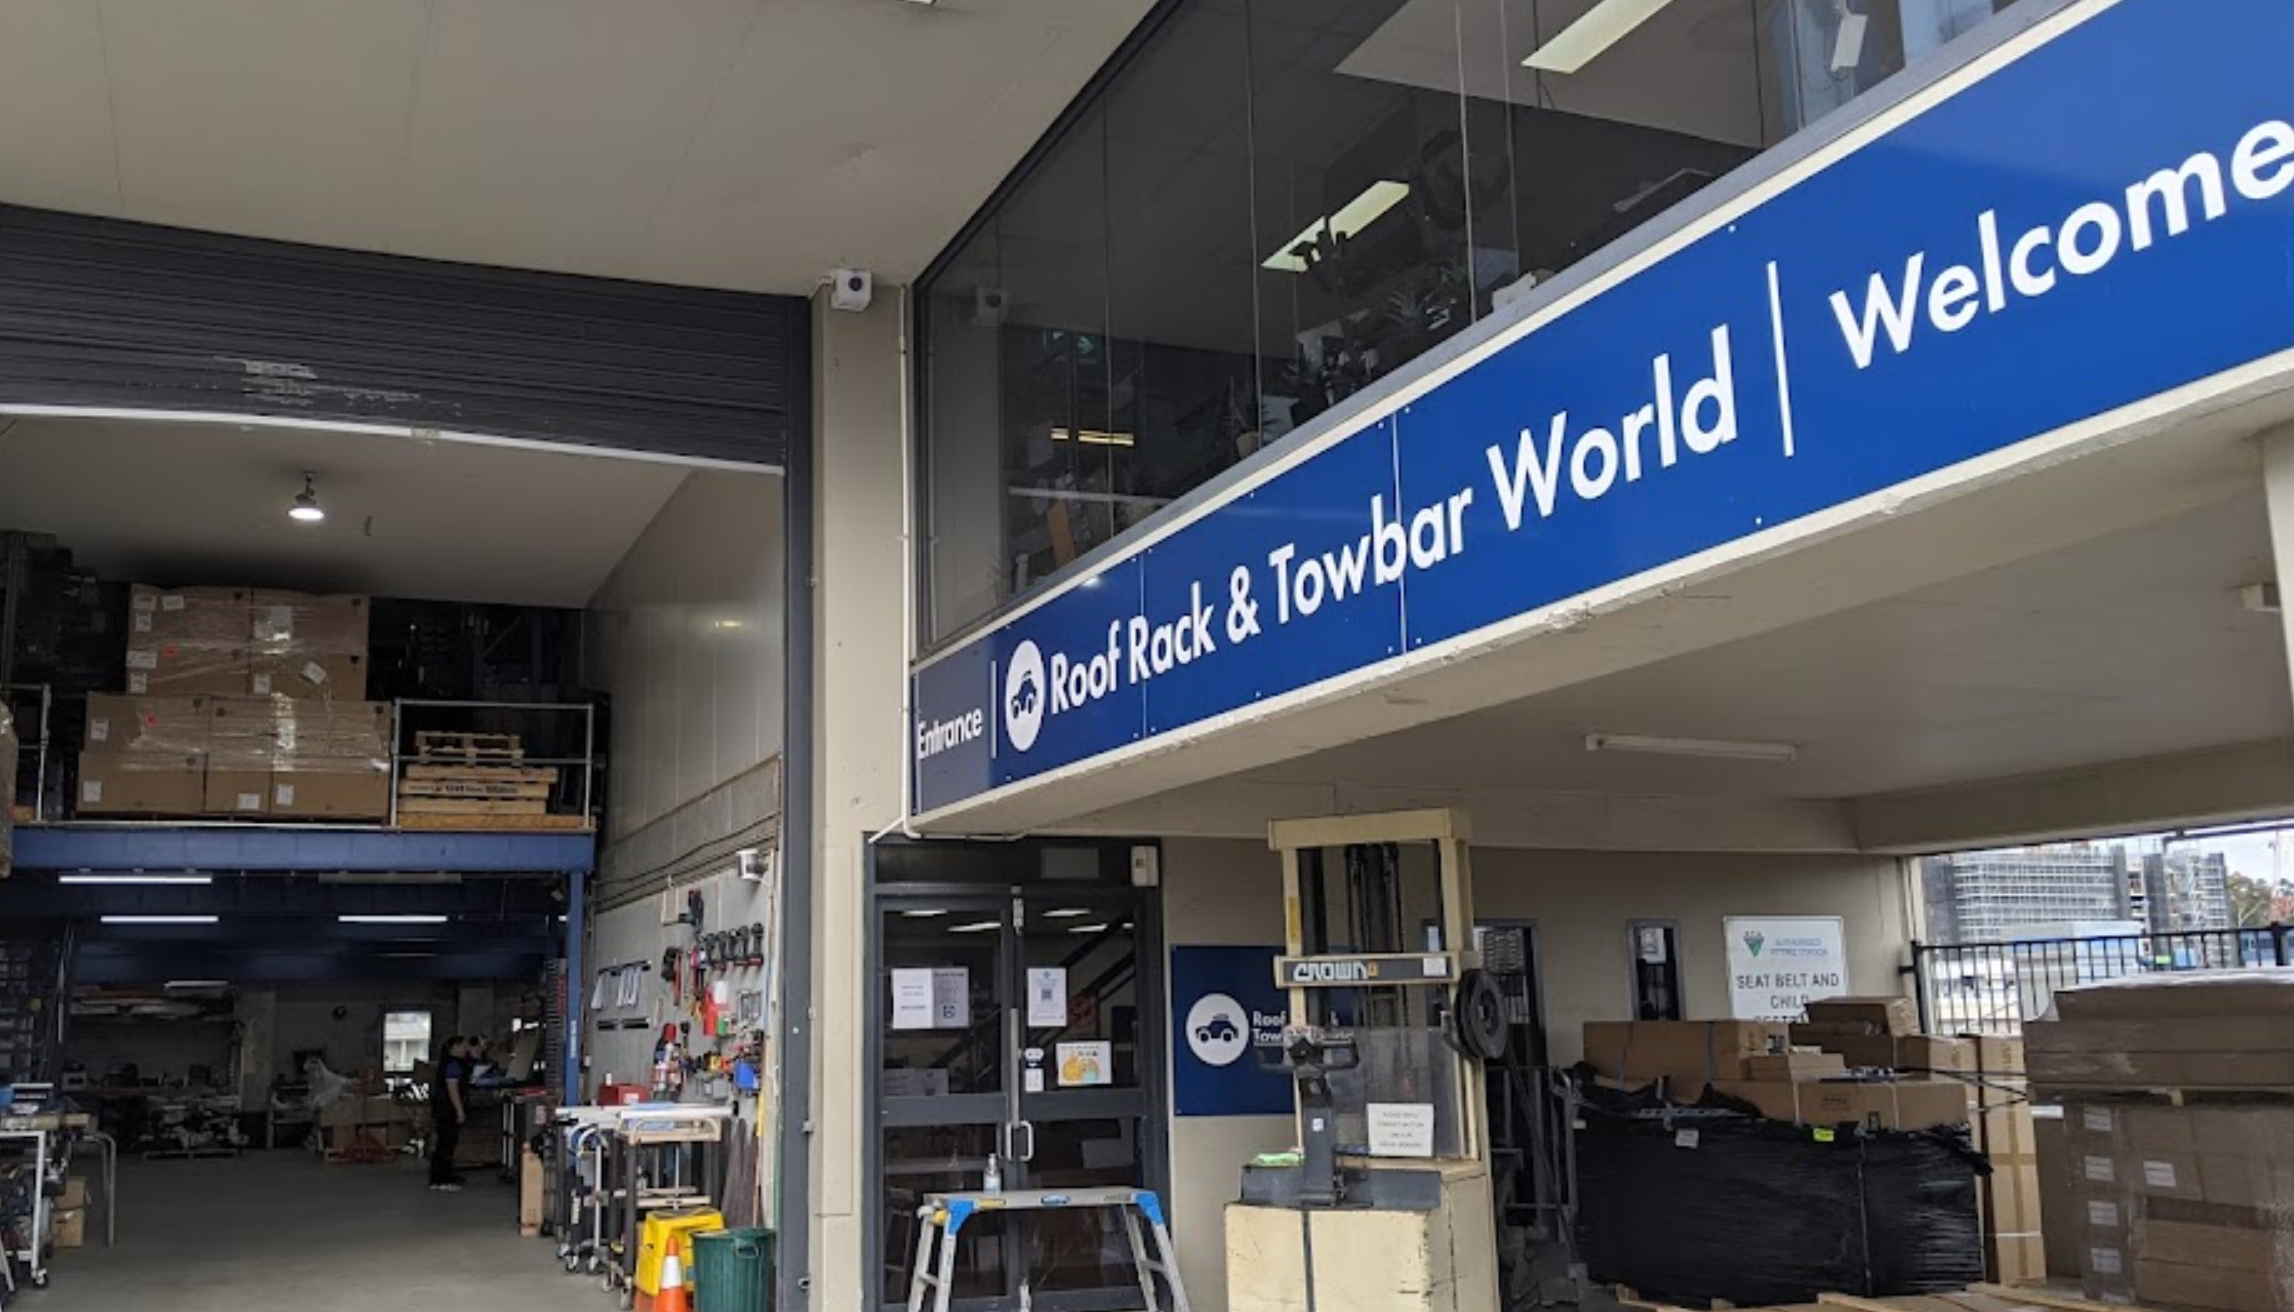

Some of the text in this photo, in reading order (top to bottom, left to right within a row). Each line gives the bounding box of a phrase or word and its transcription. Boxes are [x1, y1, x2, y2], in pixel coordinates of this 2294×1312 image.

[918, 119, 2294, 759] Entrance Roof Rack & Towbar World Welcome
[1293, 961, 1367, 982] CROWN
[1736, 972, 1840, 989] SEAT BELT AND
[1253, 1010, 1287, 1027] Roof
